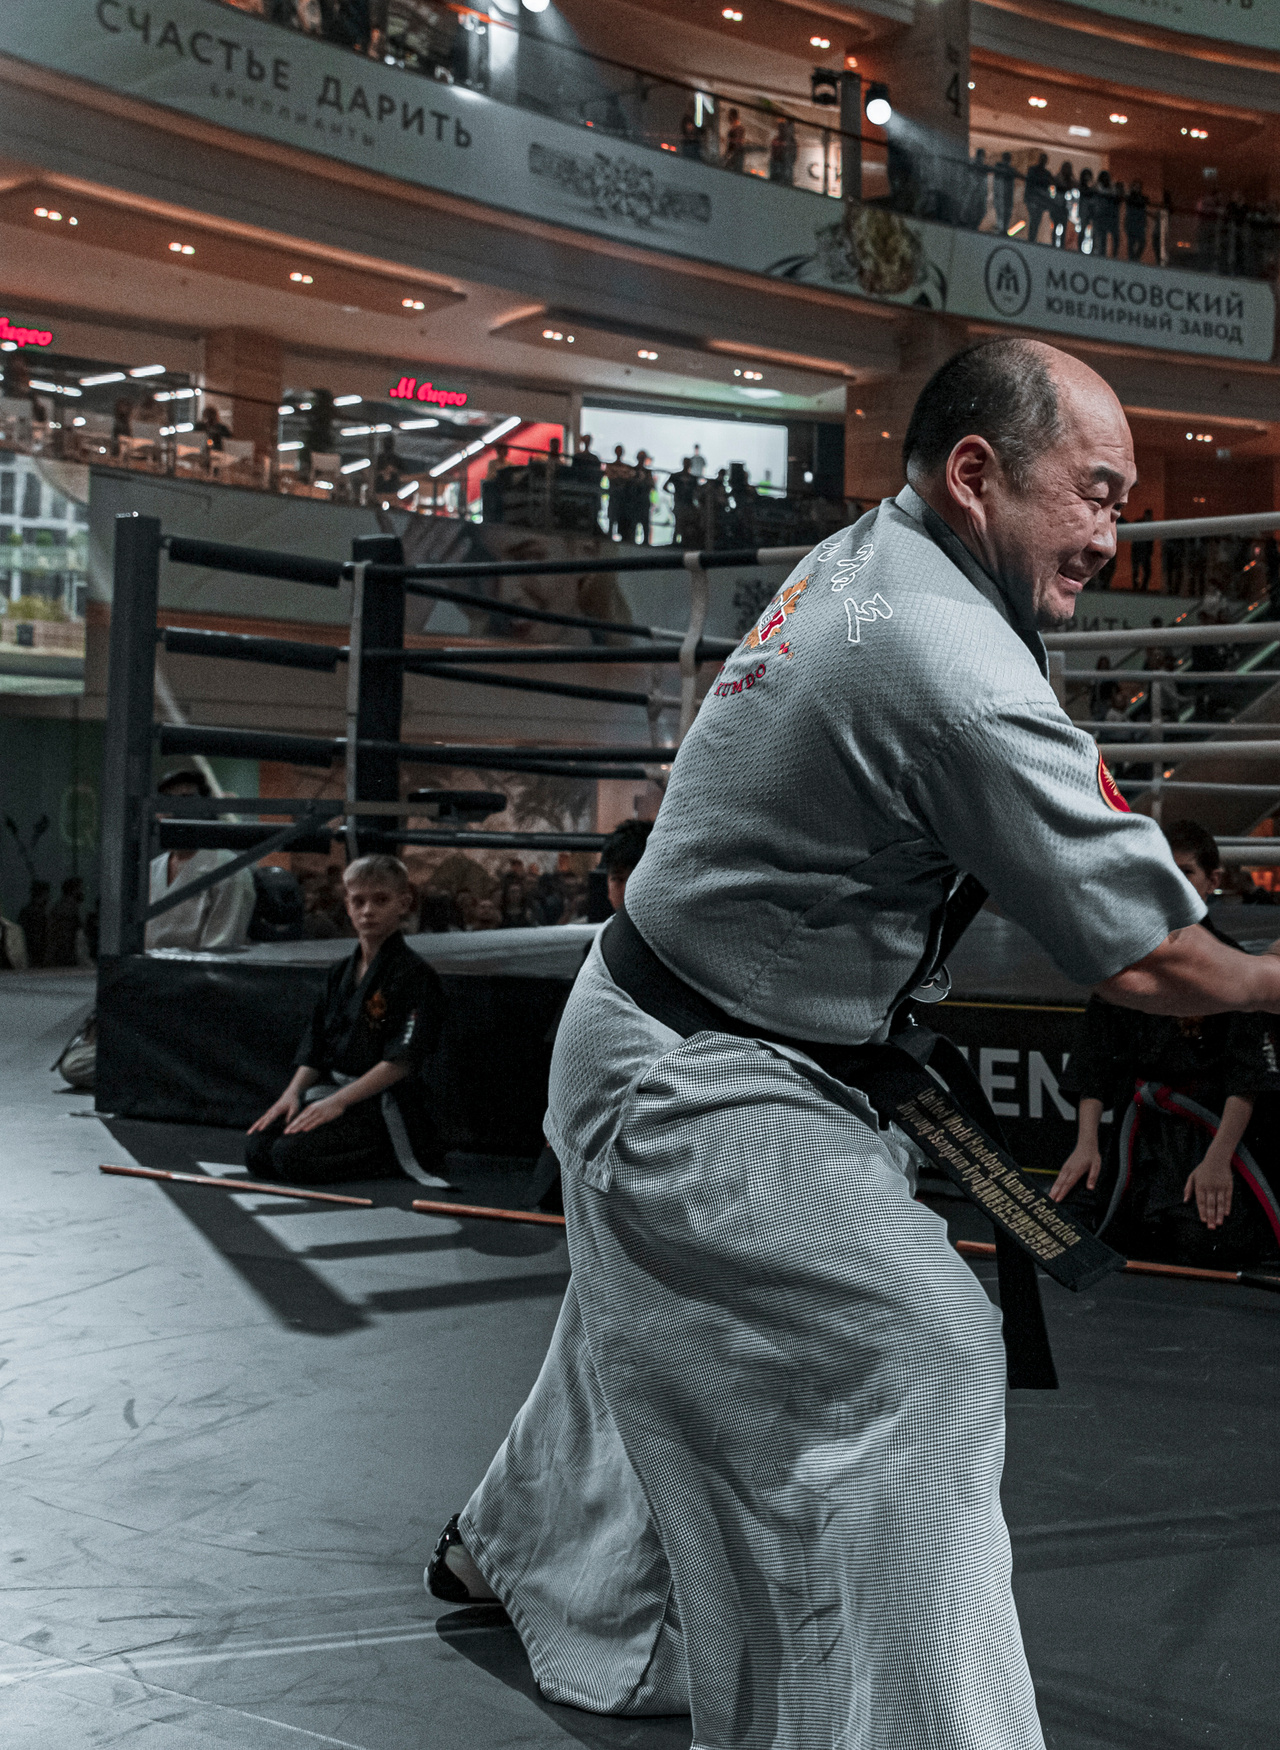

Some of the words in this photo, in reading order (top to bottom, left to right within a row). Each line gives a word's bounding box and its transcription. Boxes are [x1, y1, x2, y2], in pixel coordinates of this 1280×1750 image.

[95, 0, 291, 93] СЧАСТЬЕ
[315, 75, 474, 149] ДАРИТЬ
[1045, 296, 1173, 331] ЮВЕЛИРНЫЙ
[1179, 316, 1244, 345] ЗАВОД
[1046, 268, 1245, 319] МОСКОВСКИЙ
[895, 1098, 935, 1137] Jinyoung
[926, 1128, 970, 1170] Ssangkum
[960, 1164, 986, 1185] Ryu
[915, 1086, 955, 1120] United
[941, 1112, 977, 1143] World
[963, 1136, 1008, 1176] Haedong
[999, 1169, 1036, 1204] Kumdo
[1026, 1197, 1082, 1246] Federation
